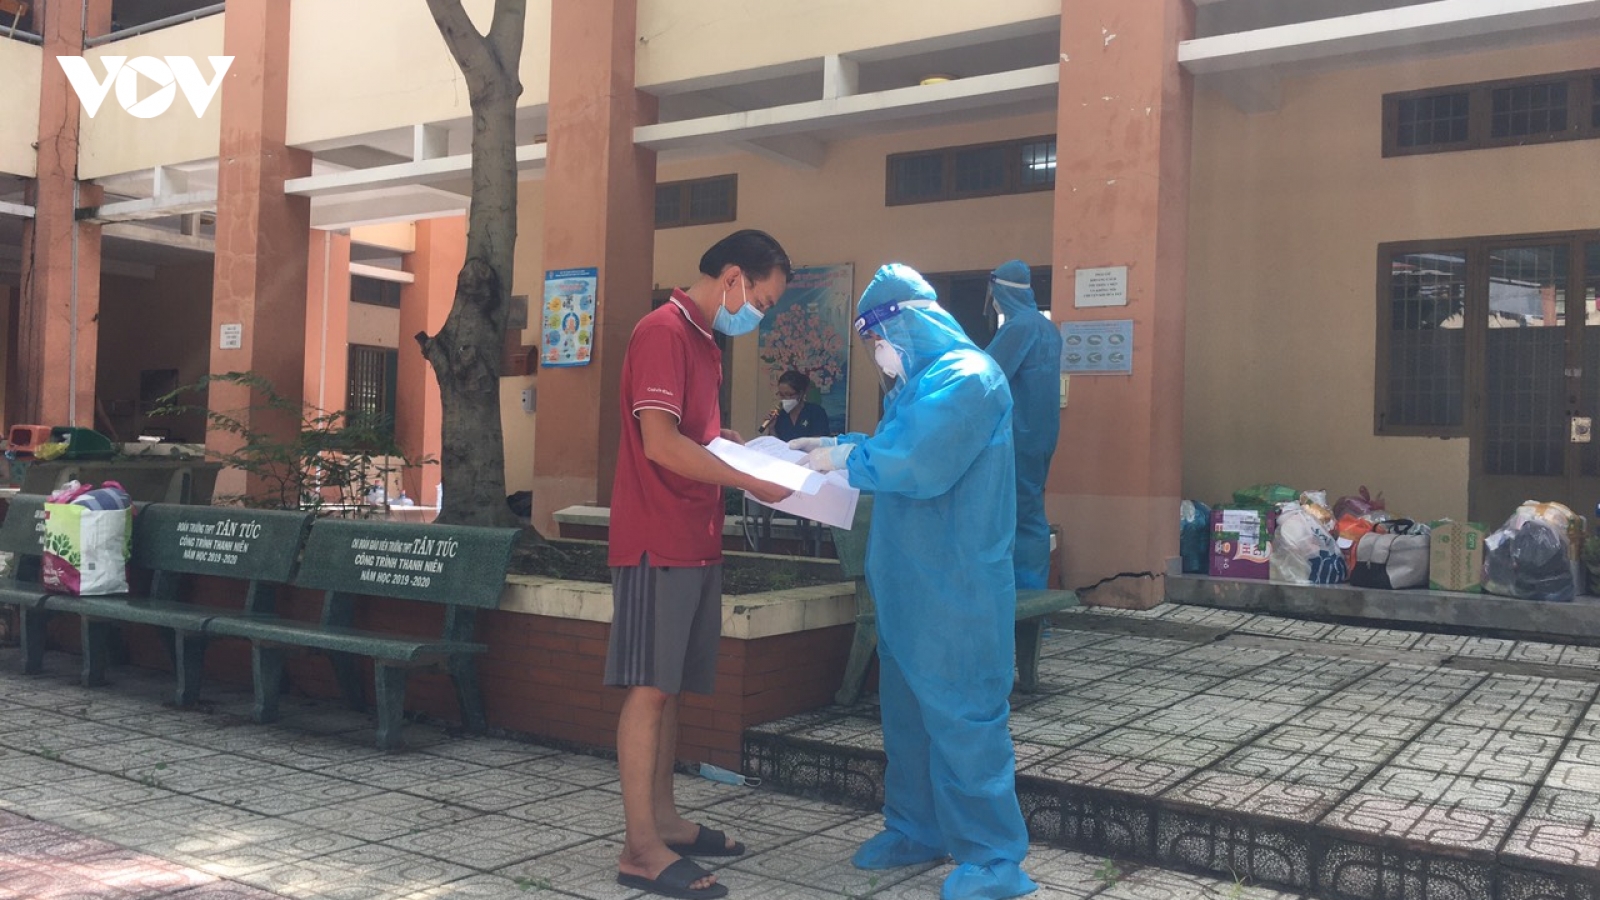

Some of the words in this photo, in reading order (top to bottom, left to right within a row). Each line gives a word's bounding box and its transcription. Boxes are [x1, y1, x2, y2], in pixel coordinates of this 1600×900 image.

[216, 518, 238, 536] TÂN
[239, 520, 261, 539] TÚC
[213, 540, 234, 551] THANH
[233, 540, 249, 553] NIÊN
[413, 535, 435, 555] TÂN
[436, 536, 458, 558] TÚC
[355, 552, 375, 566] CÔNG
[375, 554, 398, 569] TRÌNH
[398, 559, 424, 571] THANH
[424, 559, 444, 573] NIÊN
[360, 569, 376, 582] NĂM
[376, 572, 391, 584] HỌC
[391, 574, 410, 585] 2019
